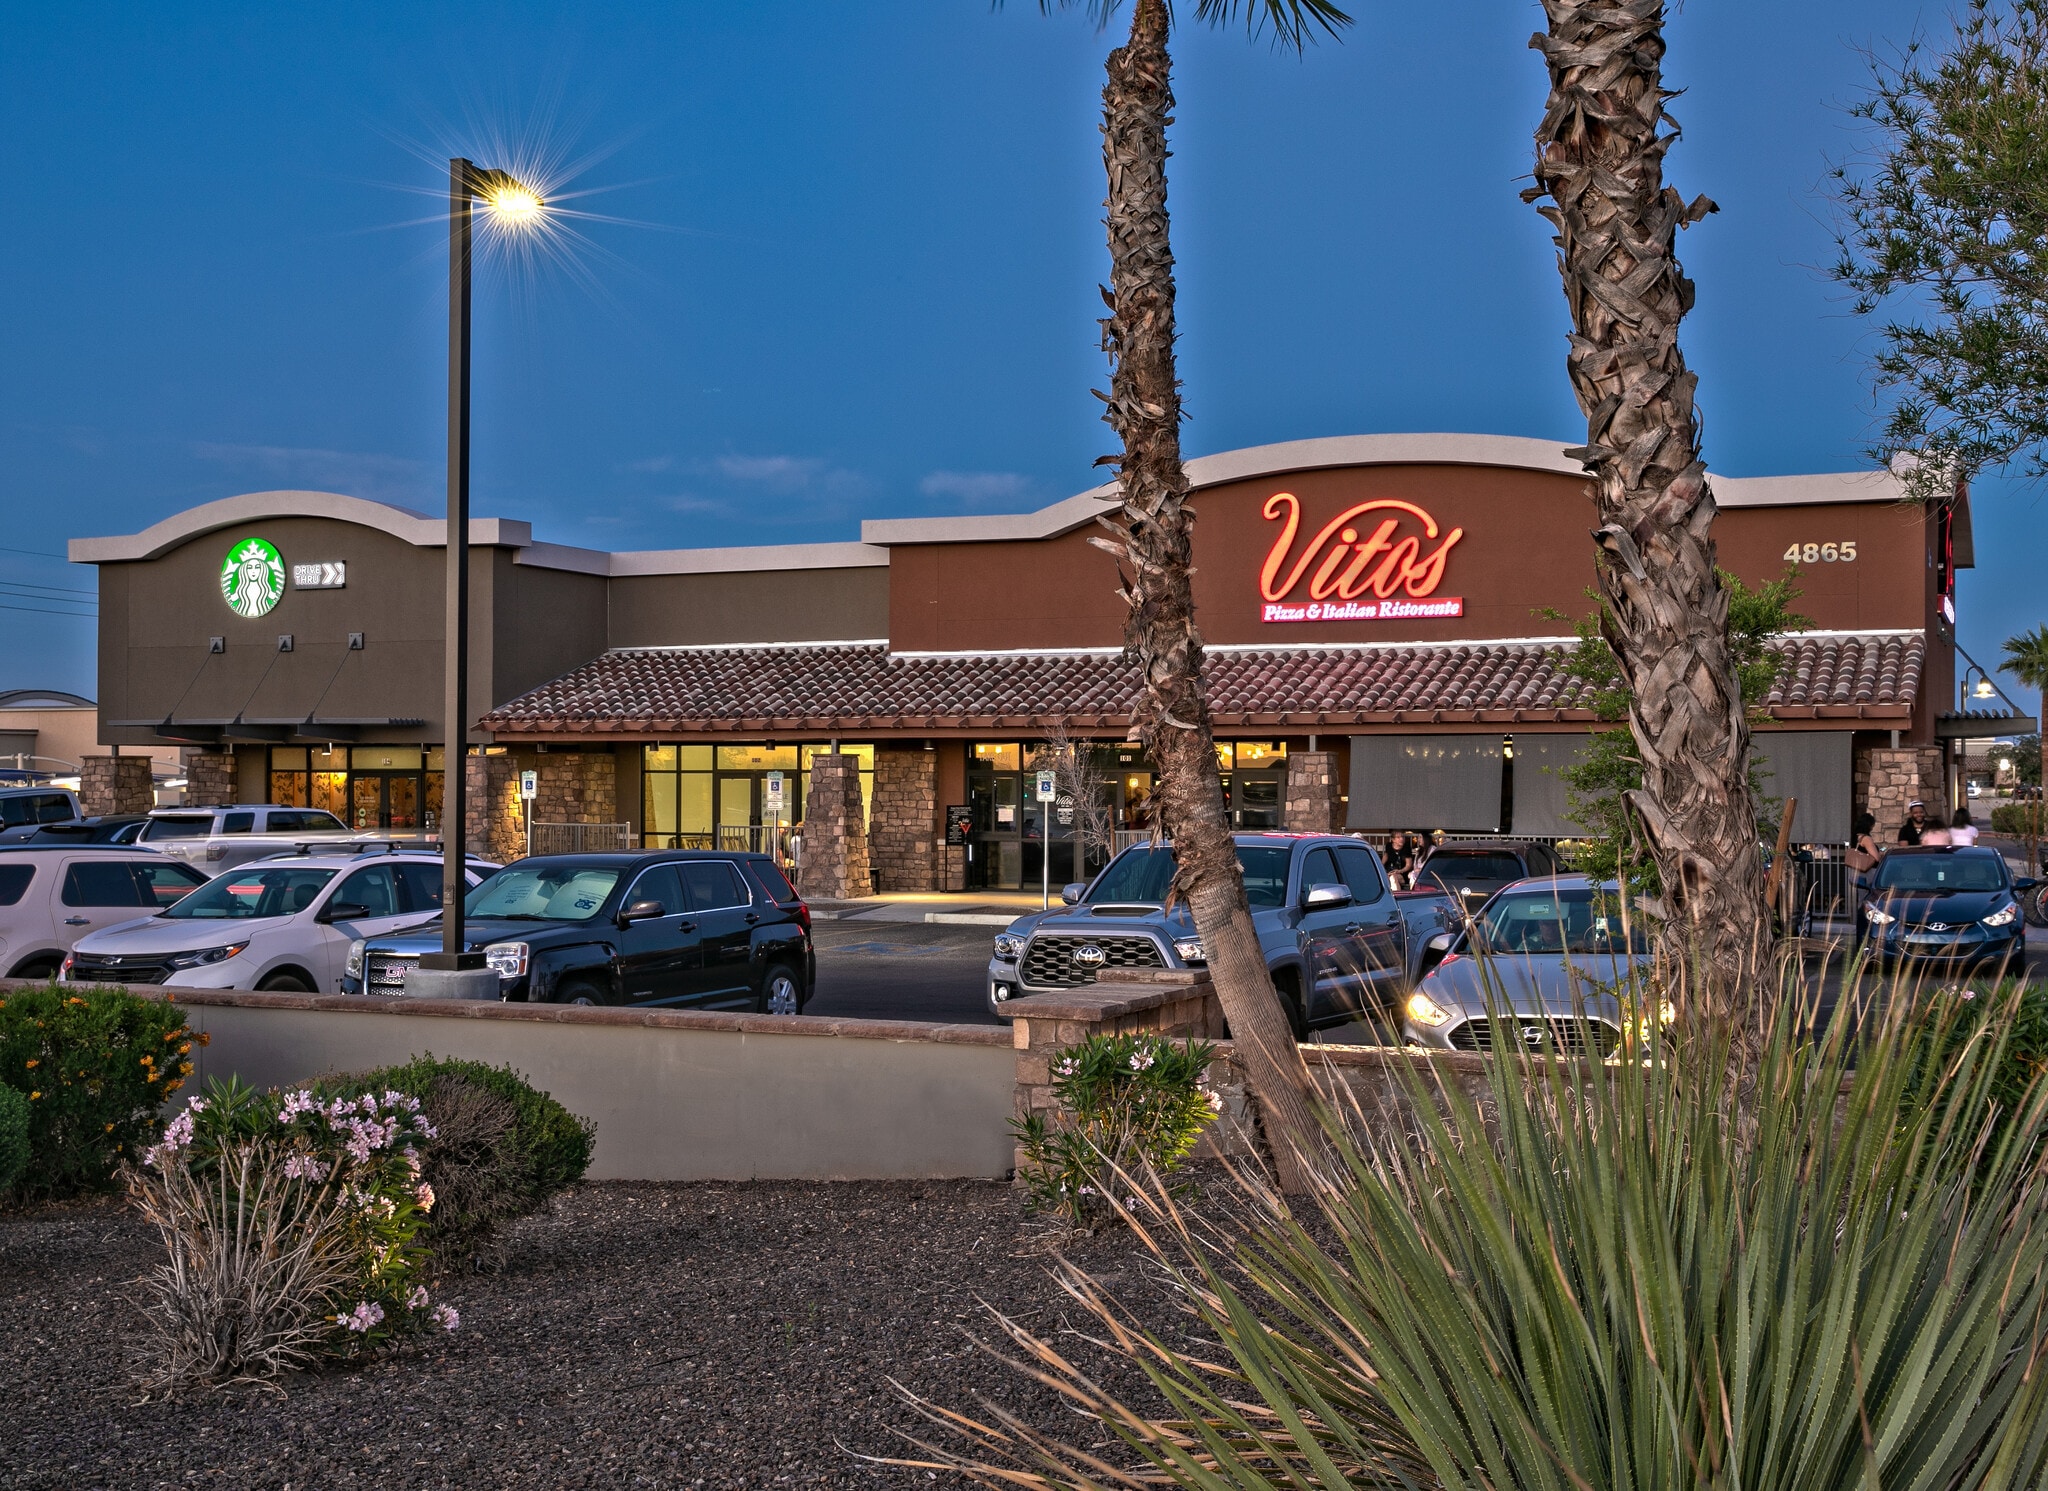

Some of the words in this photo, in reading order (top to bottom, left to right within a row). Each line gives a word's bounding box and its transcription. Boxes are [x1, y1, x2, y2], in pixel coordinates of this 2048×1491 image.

[1783, 541, 1857, 564] 4865
[294, 564, 321, 575] DRIVE
[295, 574, 320, 585] THRU
[1263, 605, 1305, 621] Pizza
[1306, 604, 1321, 619] &
[1321, 603, 1376, 619] Italian
[1379, 601, 1460, 618] Ristorante
